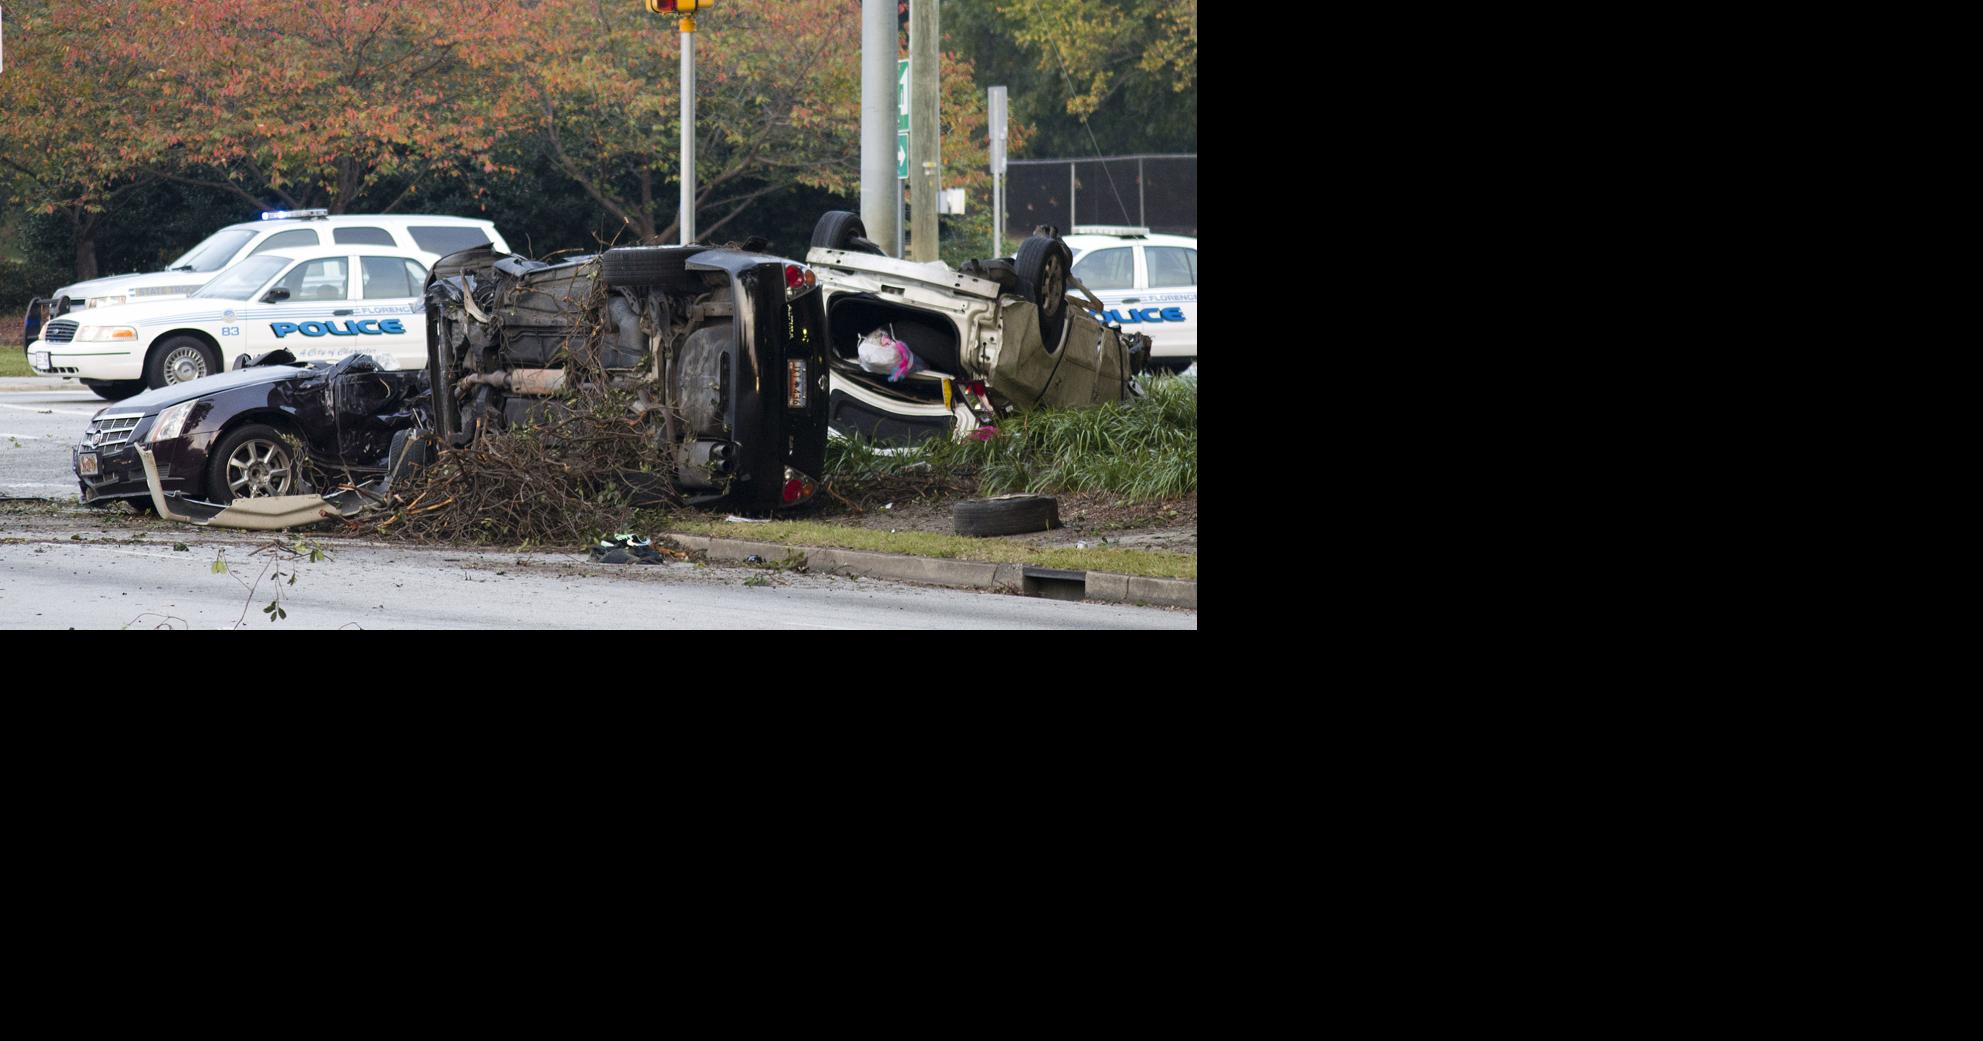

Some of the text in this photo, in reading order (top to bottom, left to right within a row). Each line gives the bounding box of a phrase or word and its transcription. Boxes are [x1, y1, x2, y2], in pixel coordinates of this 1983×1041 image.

[362, 305, 411, 314] FLORENC
[1090, 306, 1186, 323] OLICE
[271, 318, 406, 338] POLICE
